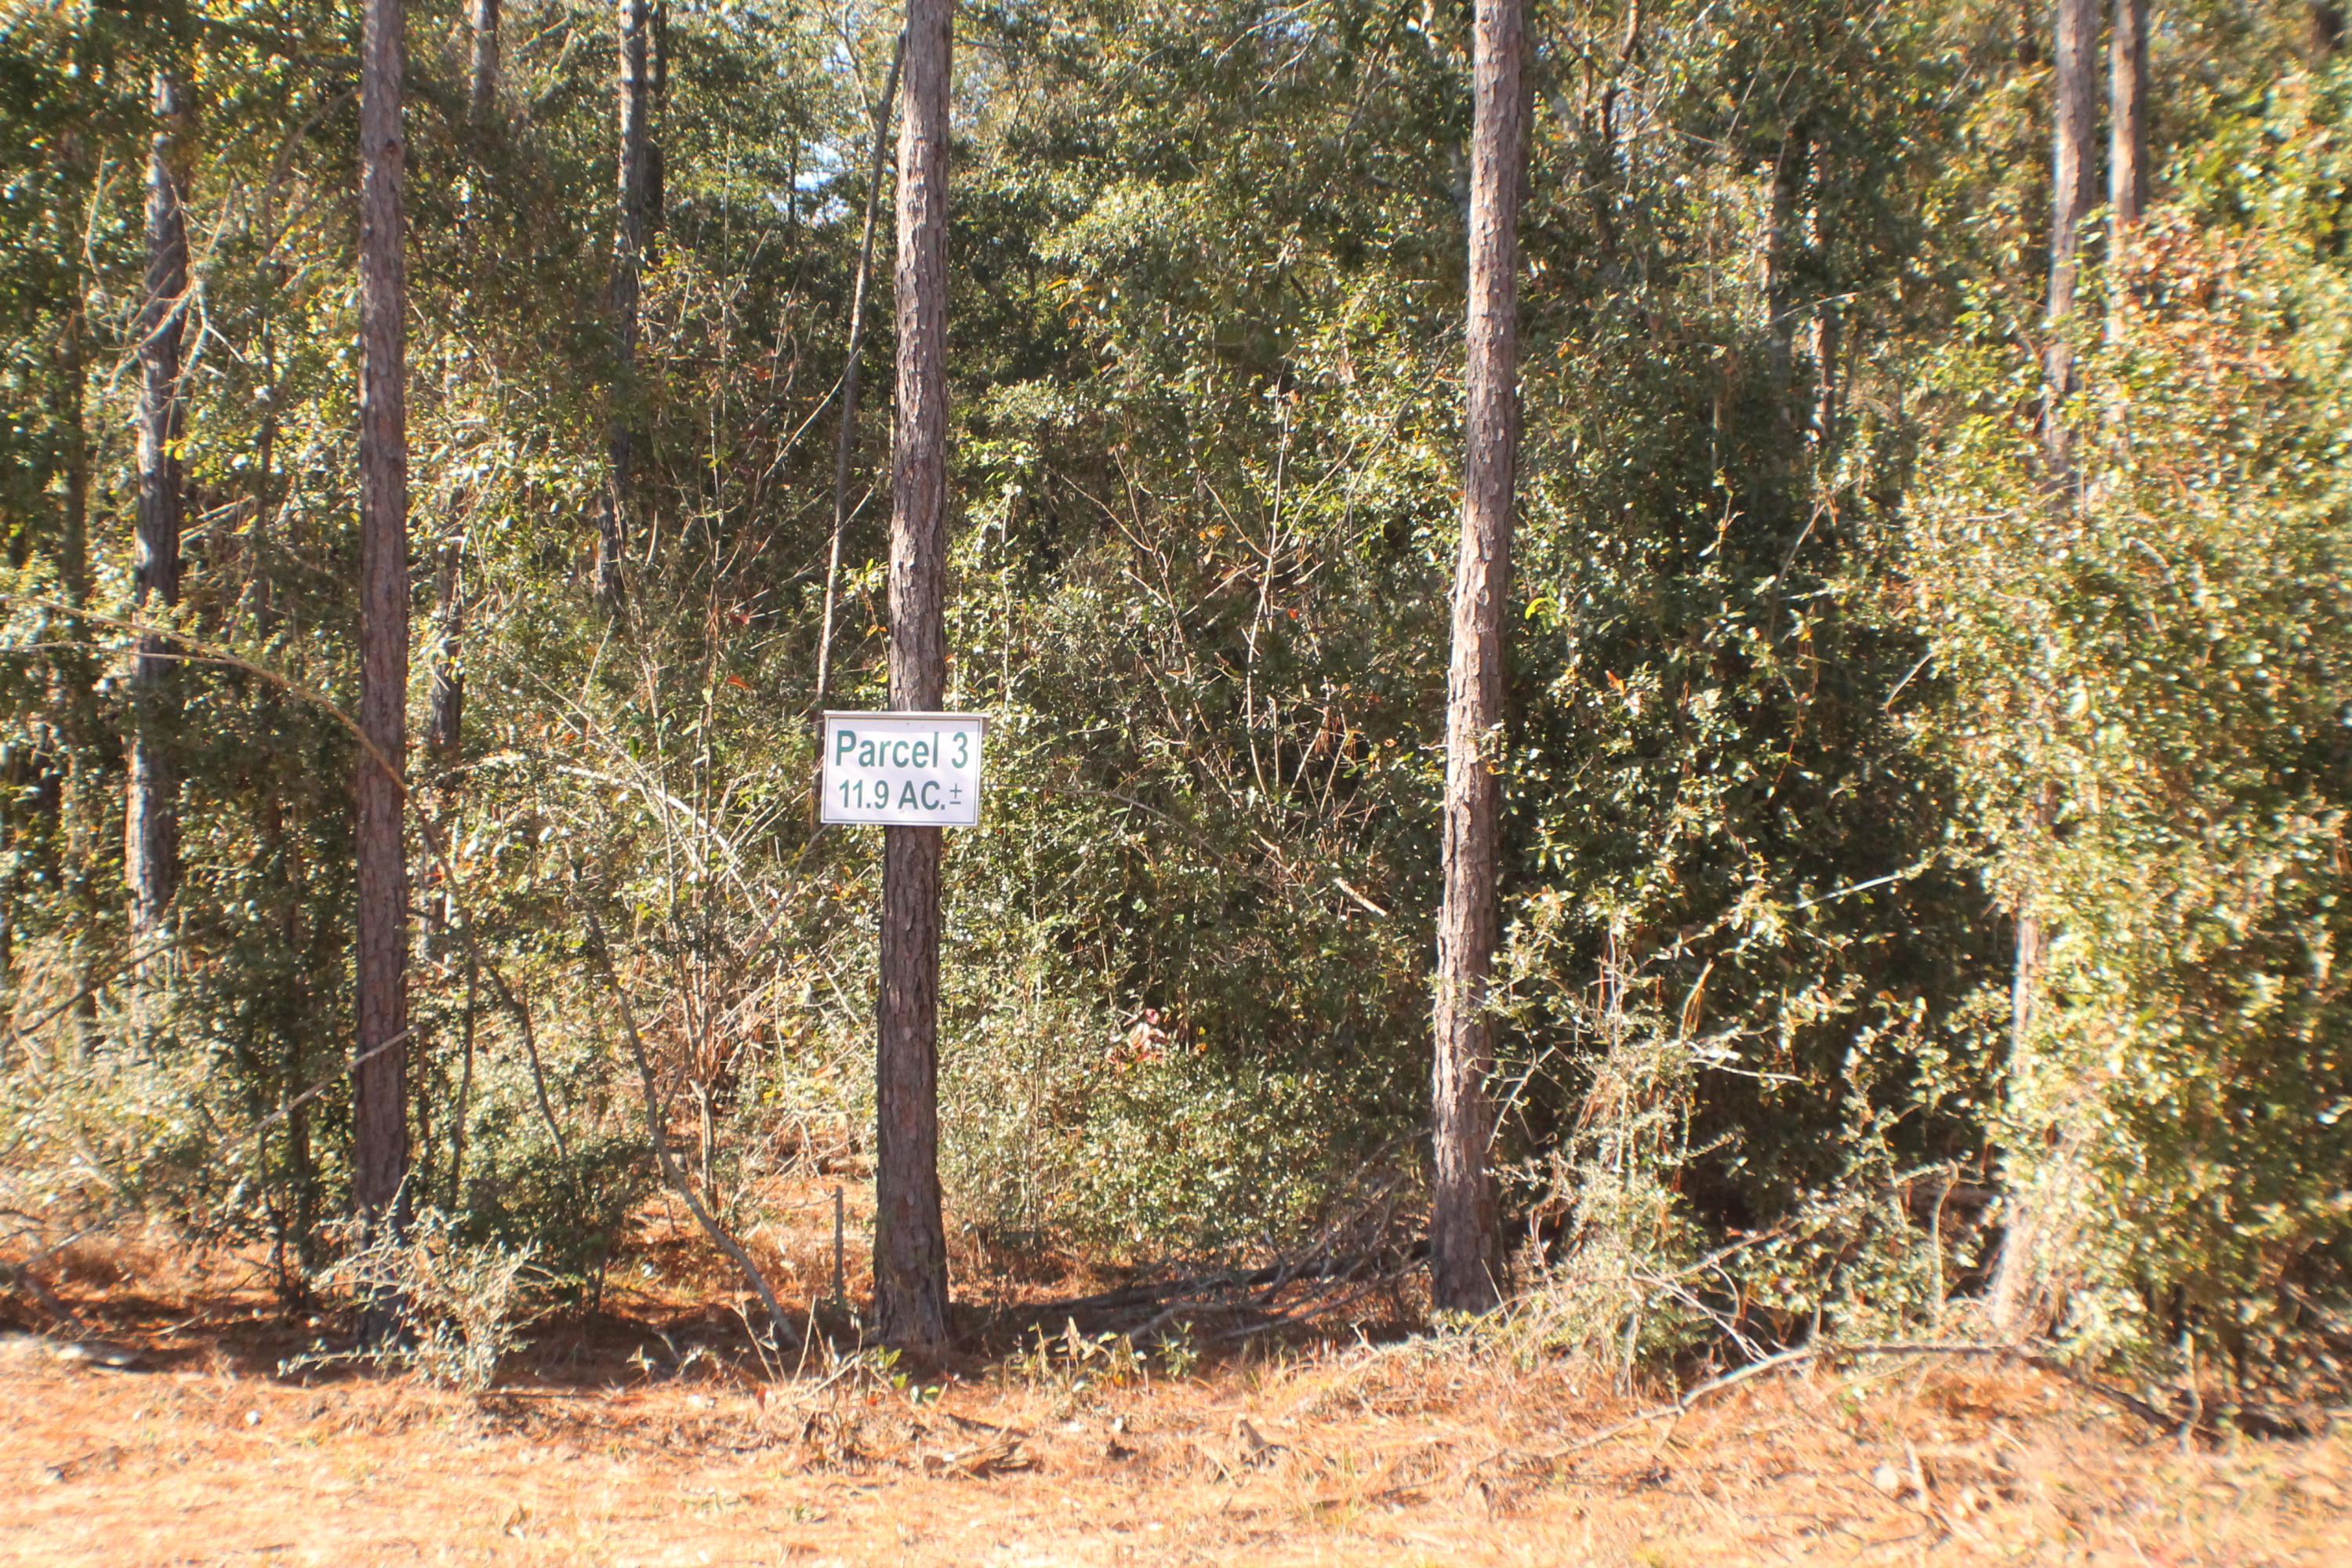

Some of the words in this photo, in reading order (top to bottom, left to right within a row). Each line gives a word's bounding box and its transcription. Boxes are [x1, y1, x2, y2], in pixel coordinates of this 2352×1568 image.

[836, 730, 939, 768] Parcel
[951, 731, 968, 768] 3
[839, 779, 889, 809] 11.9
